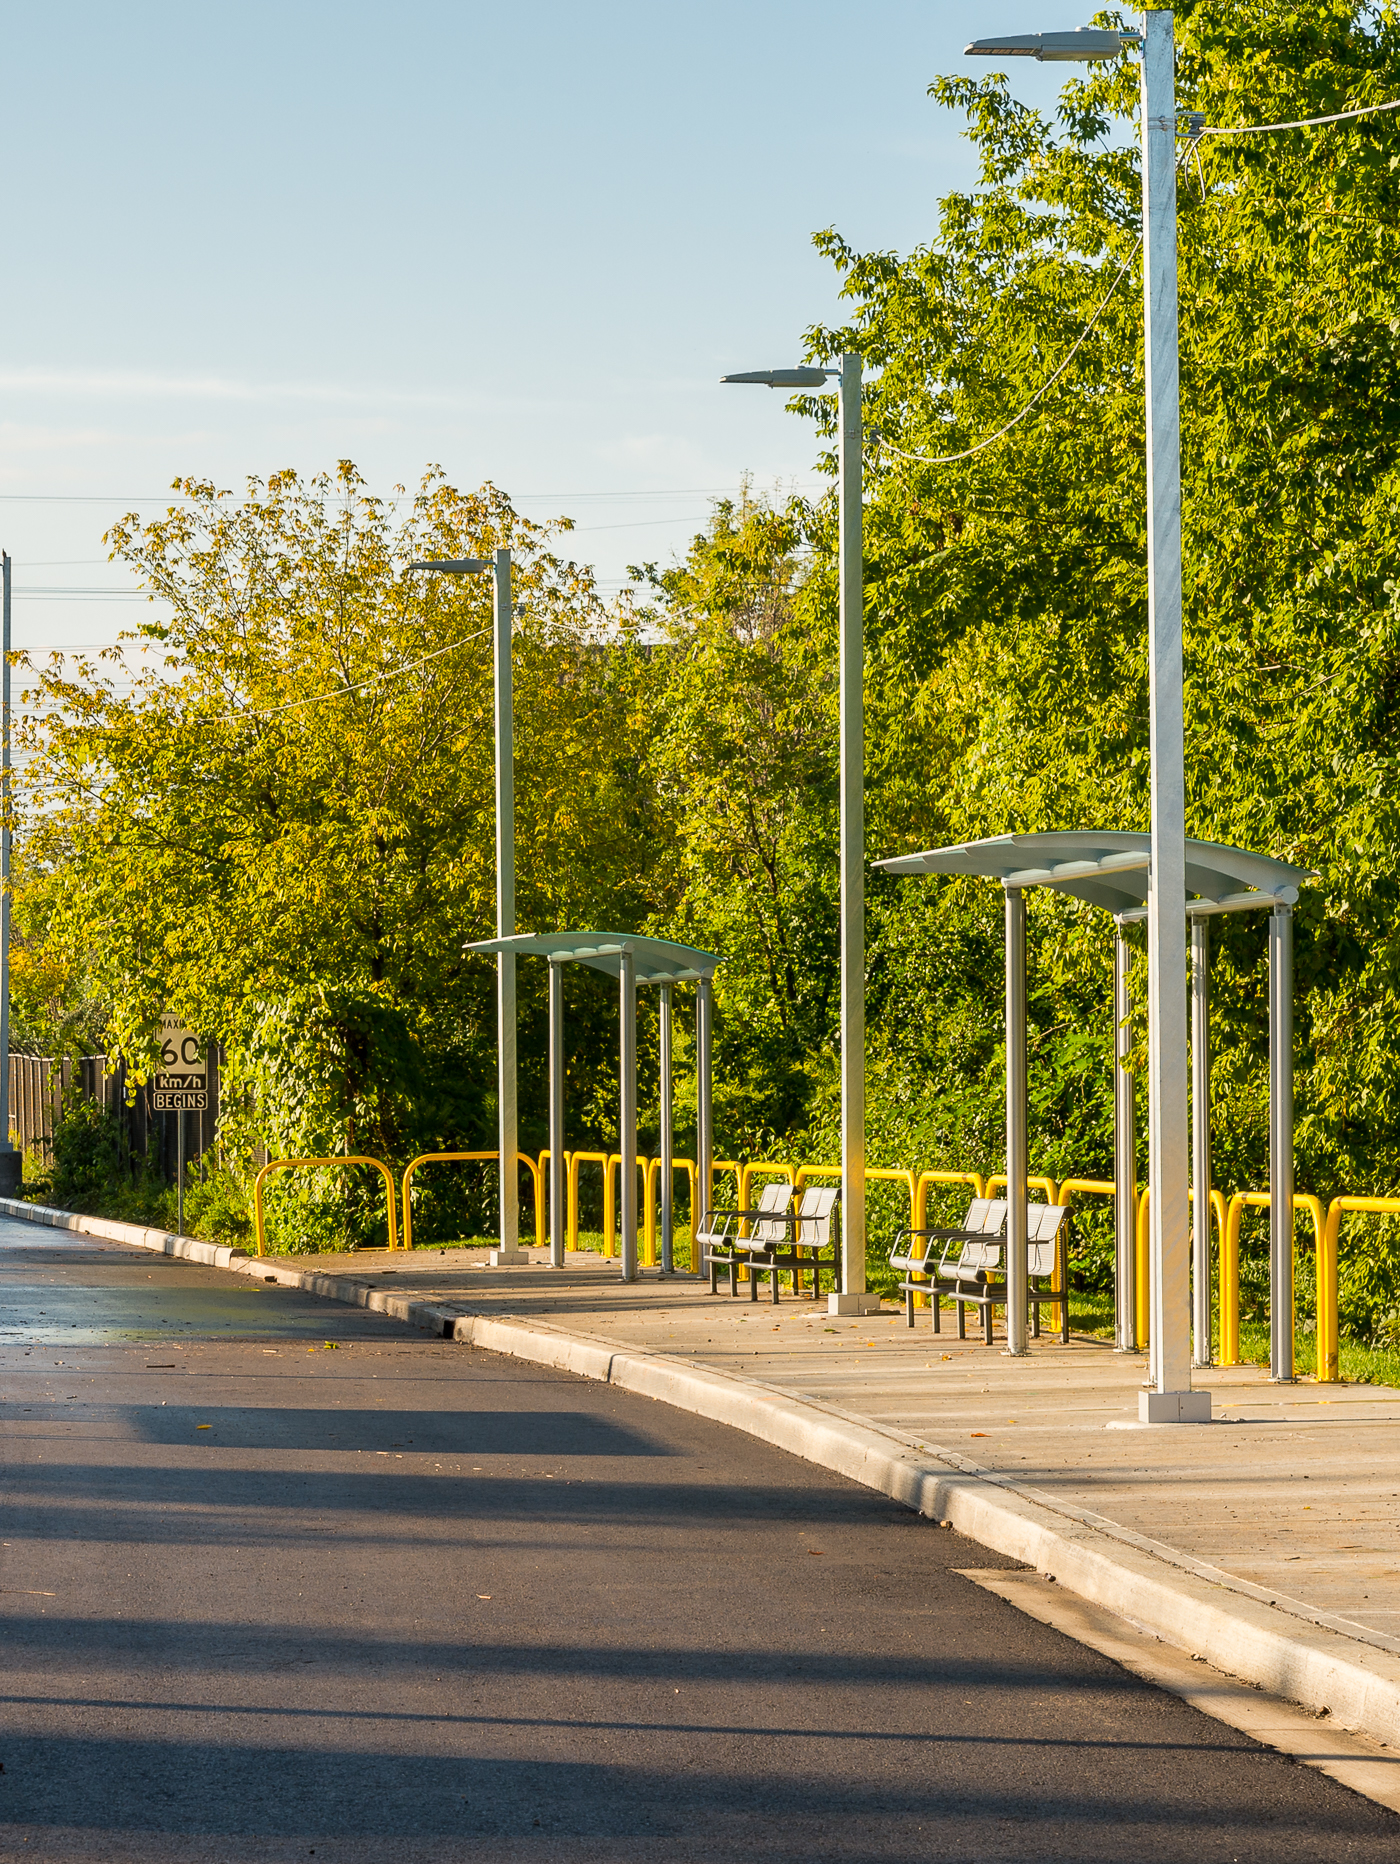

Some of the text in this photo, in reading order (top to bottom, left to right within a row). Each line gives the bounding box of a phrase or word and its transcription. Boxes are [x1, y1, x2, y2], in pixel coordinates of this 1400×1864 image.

[161, 1037, 200, 1066] 60
[160, 1075, 201, 1088] km/h
[156, 1094, 205, 1108] BEGINS
